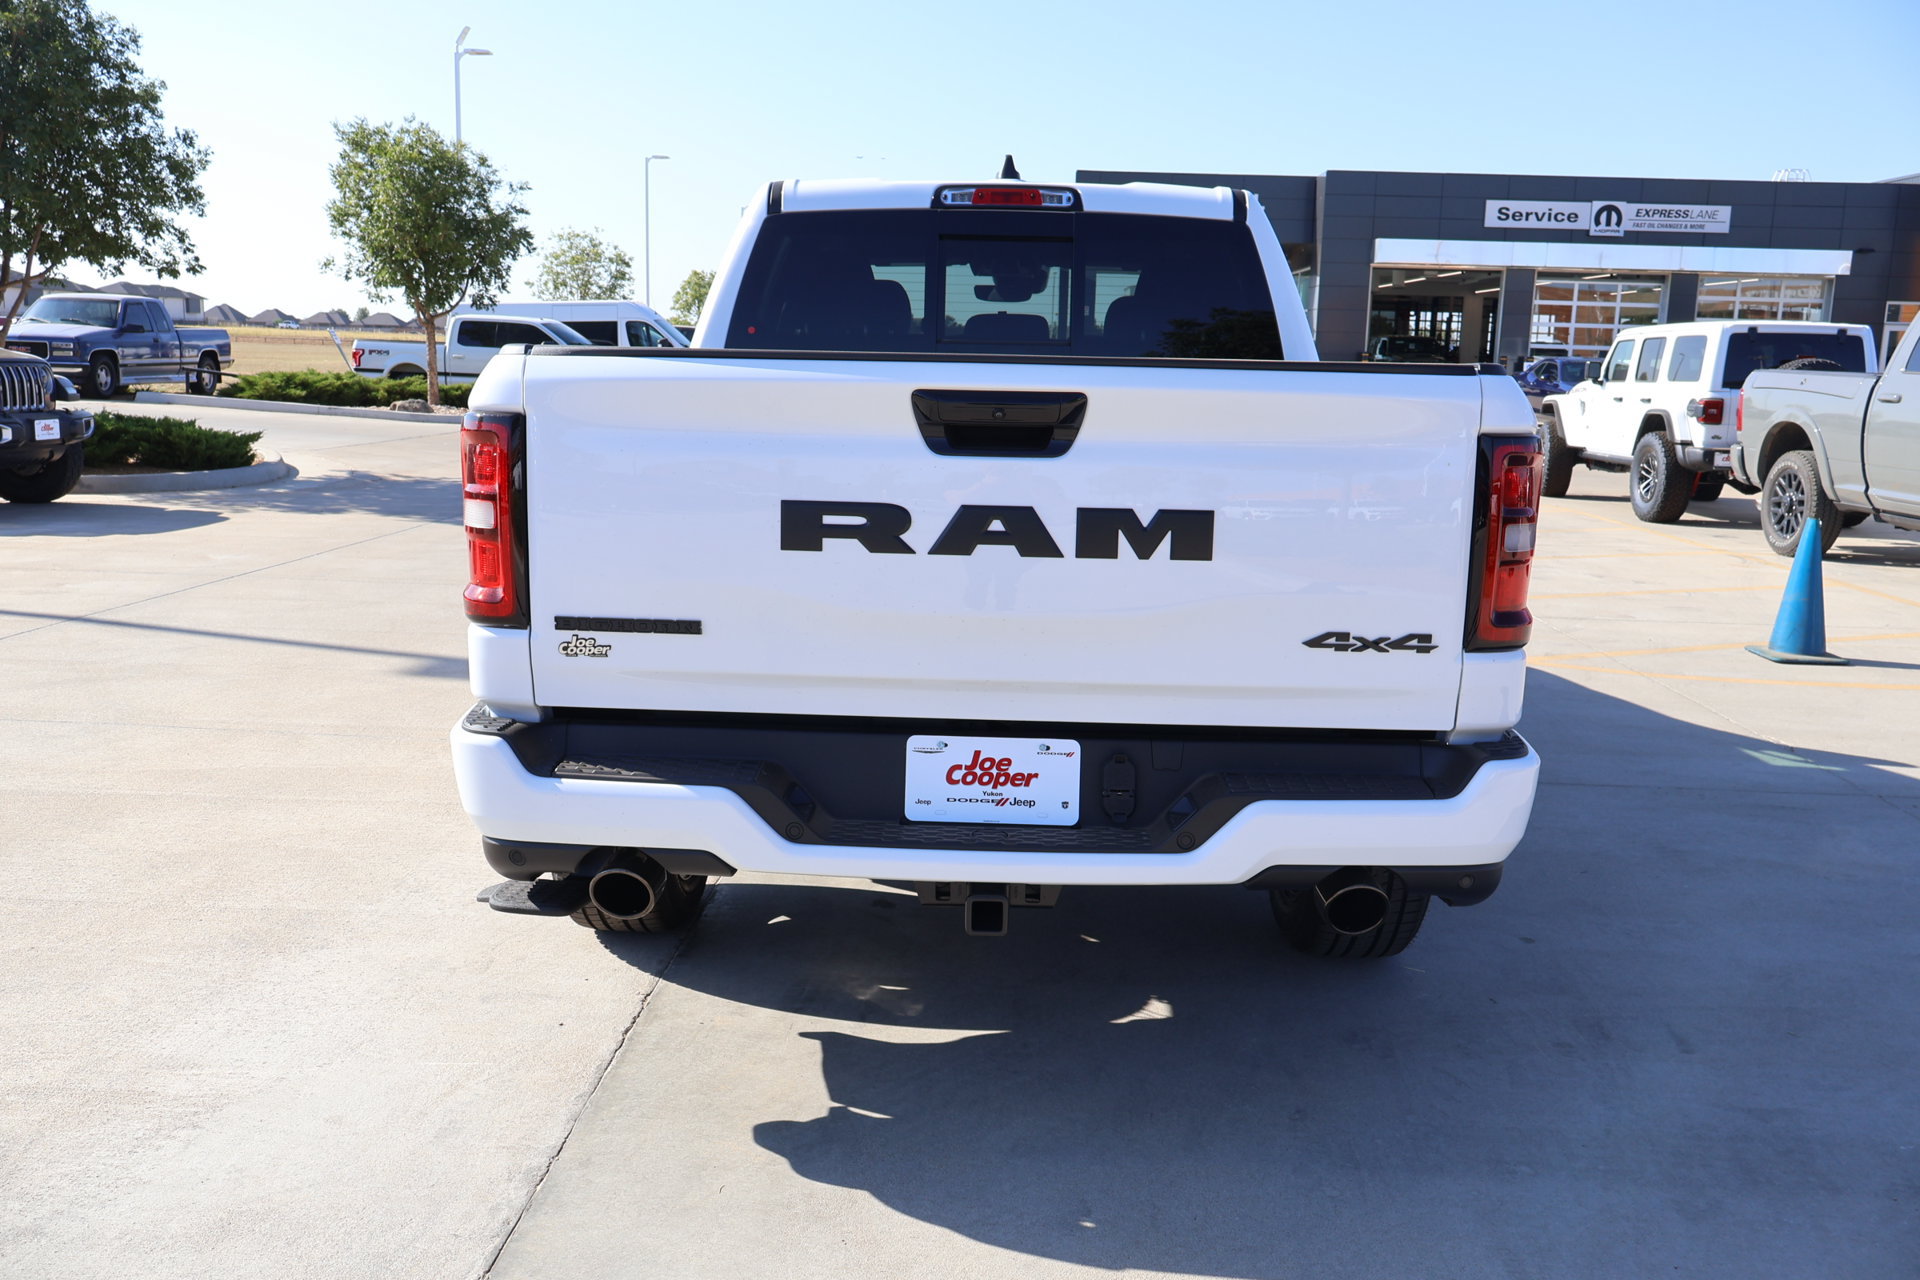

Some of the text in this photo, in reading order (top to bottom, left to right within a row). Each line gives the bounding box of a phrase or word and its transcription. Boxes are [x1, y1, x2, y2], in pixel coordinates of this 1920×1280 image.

[1496, 206, 1579, 223] Service
[780, 499, 1215, 561] RAM
[558, 641, 611, 656] Cooper
[568, 634, 596, 647] Joe
[1301, 631, 1440, 654] 4x4
[964, 750, 1013, 772] Joe
[945, 764, 1039, 790] Cooper
[914, 798, 932, 806] Jeep
[1009, 797, 1036, 809] Jeep
